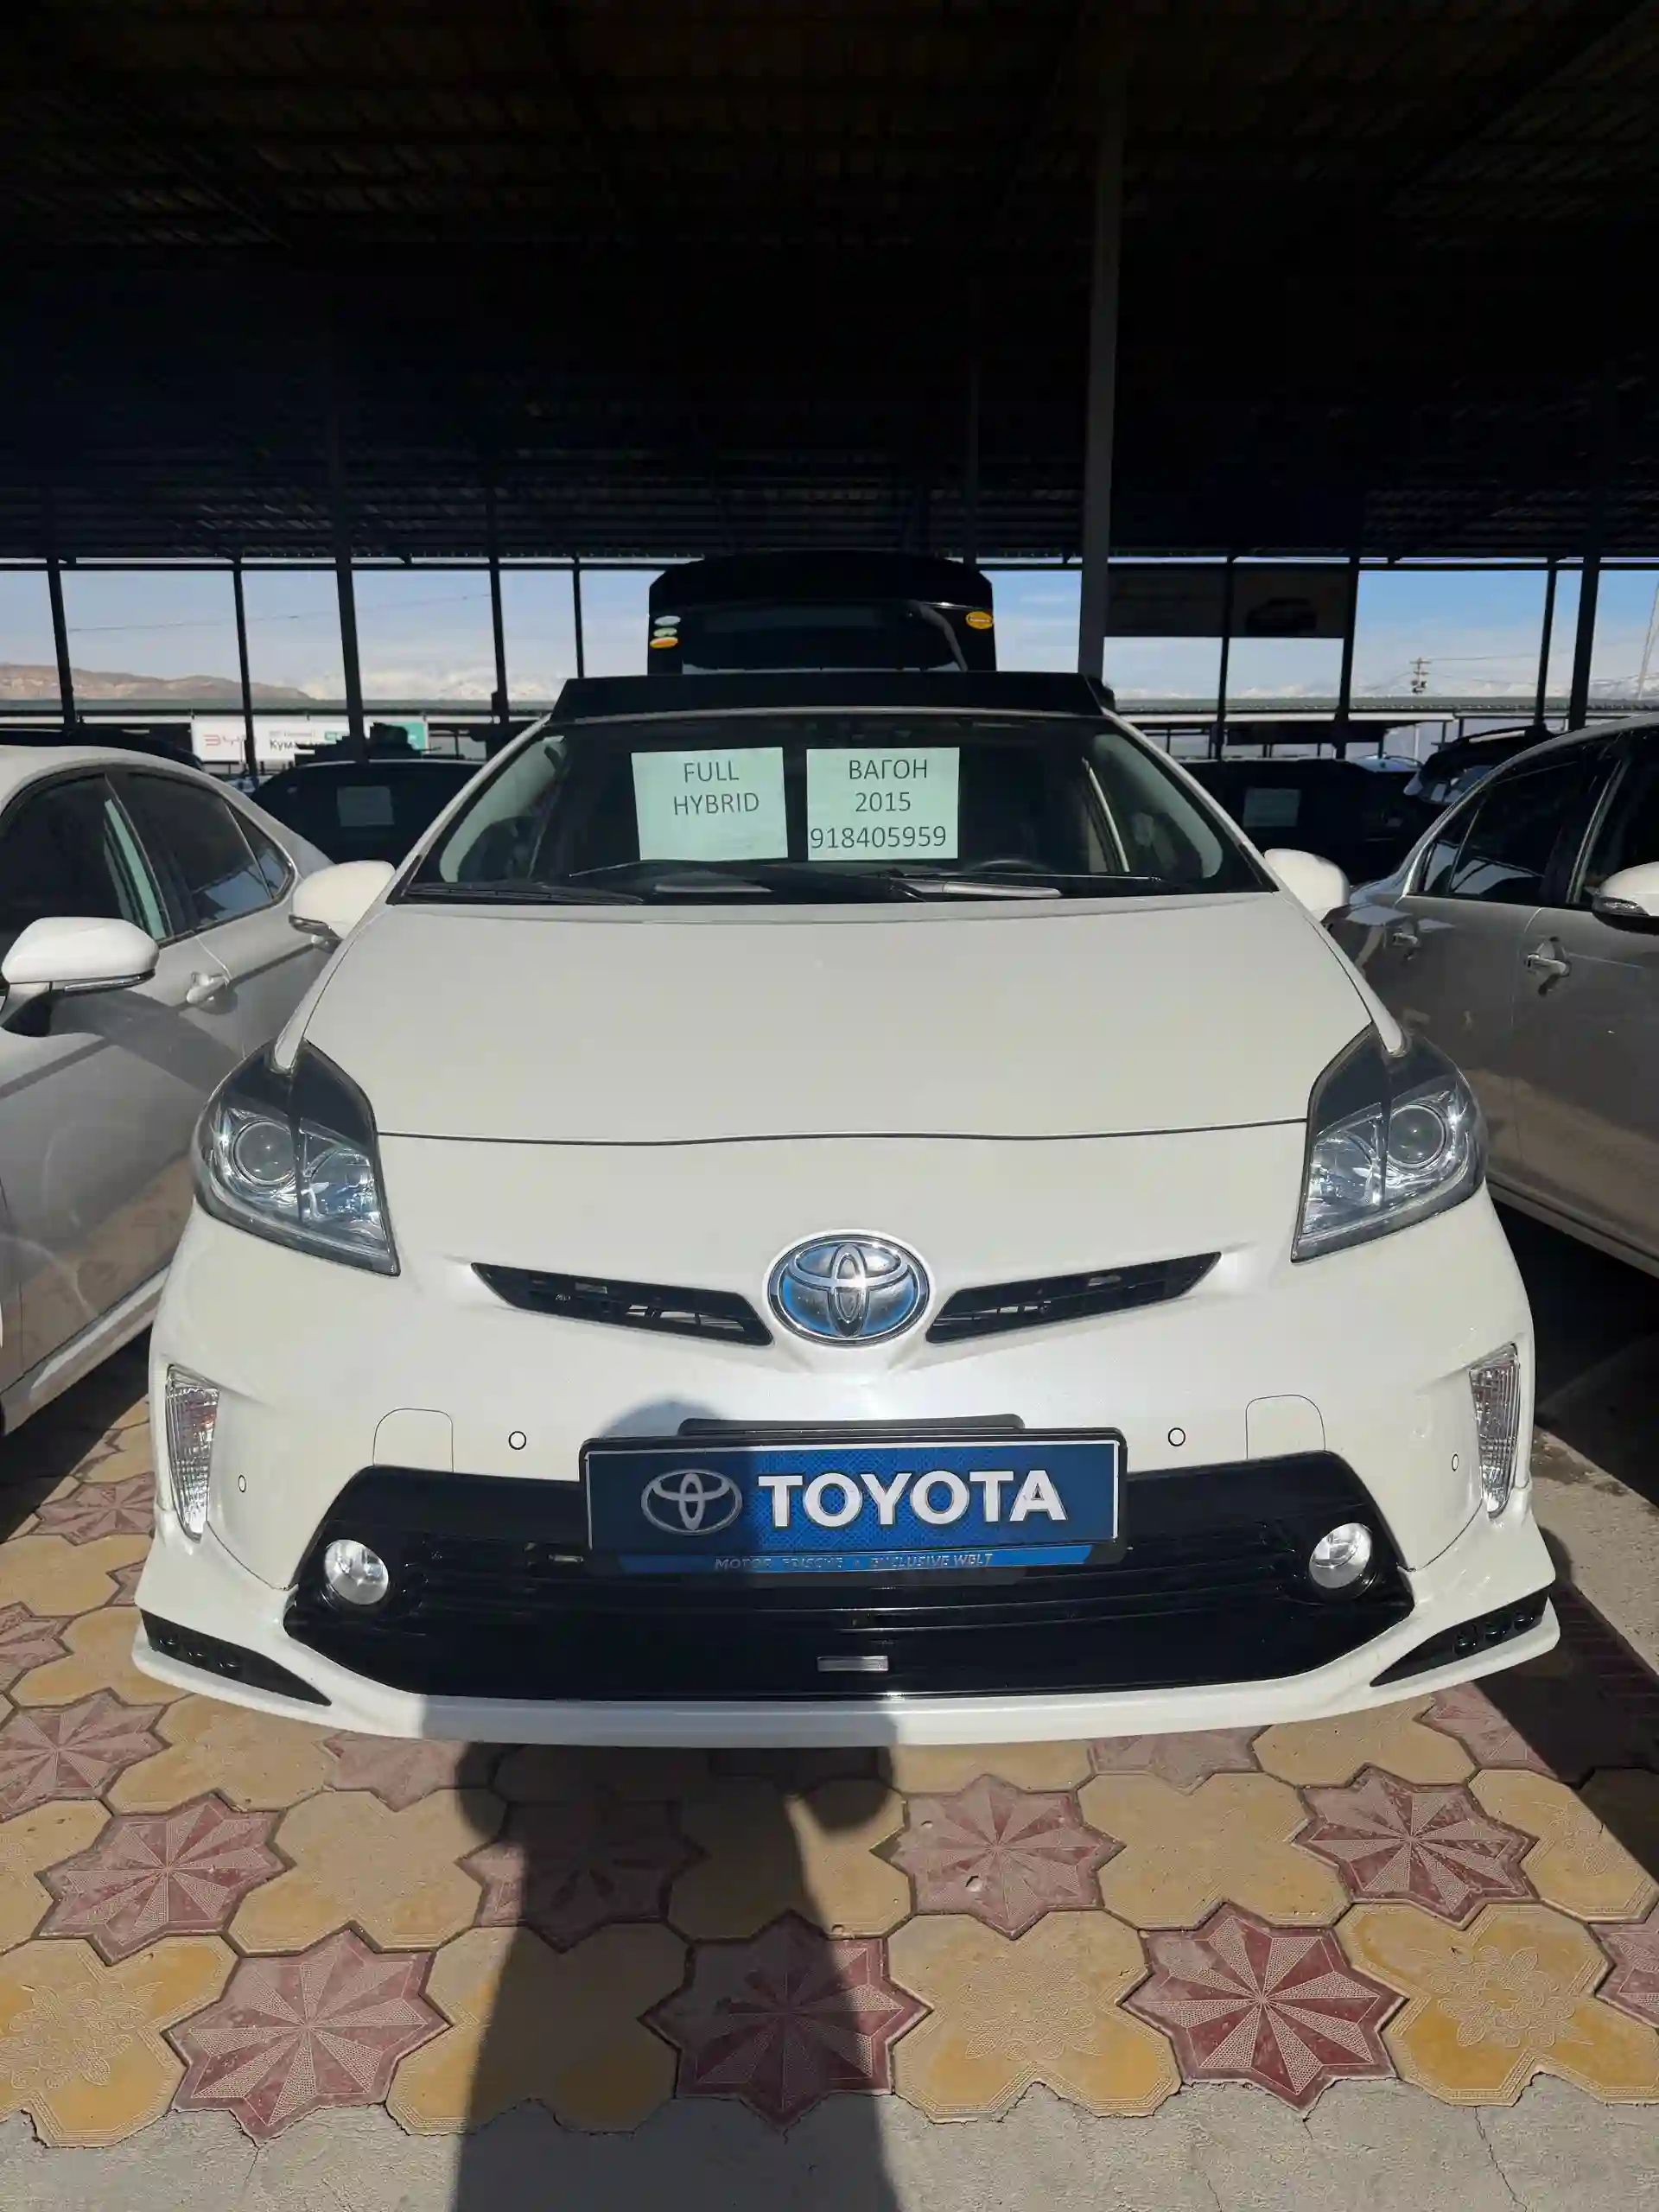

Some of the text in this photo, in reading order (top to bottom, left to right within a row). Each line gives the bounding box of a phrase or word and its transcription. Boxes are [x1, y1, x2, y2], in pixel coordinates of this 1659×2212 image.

[684, 760, 740, 783] FULL
[849, 759, 927, 779] ВАГОН
[674, 792, 759, 816] HYBRID
[855, 791, 911, 812] 2015
[810, 826, 945, 849] 918405959
[759, 1470, 1066, 1527] TOYOTA
